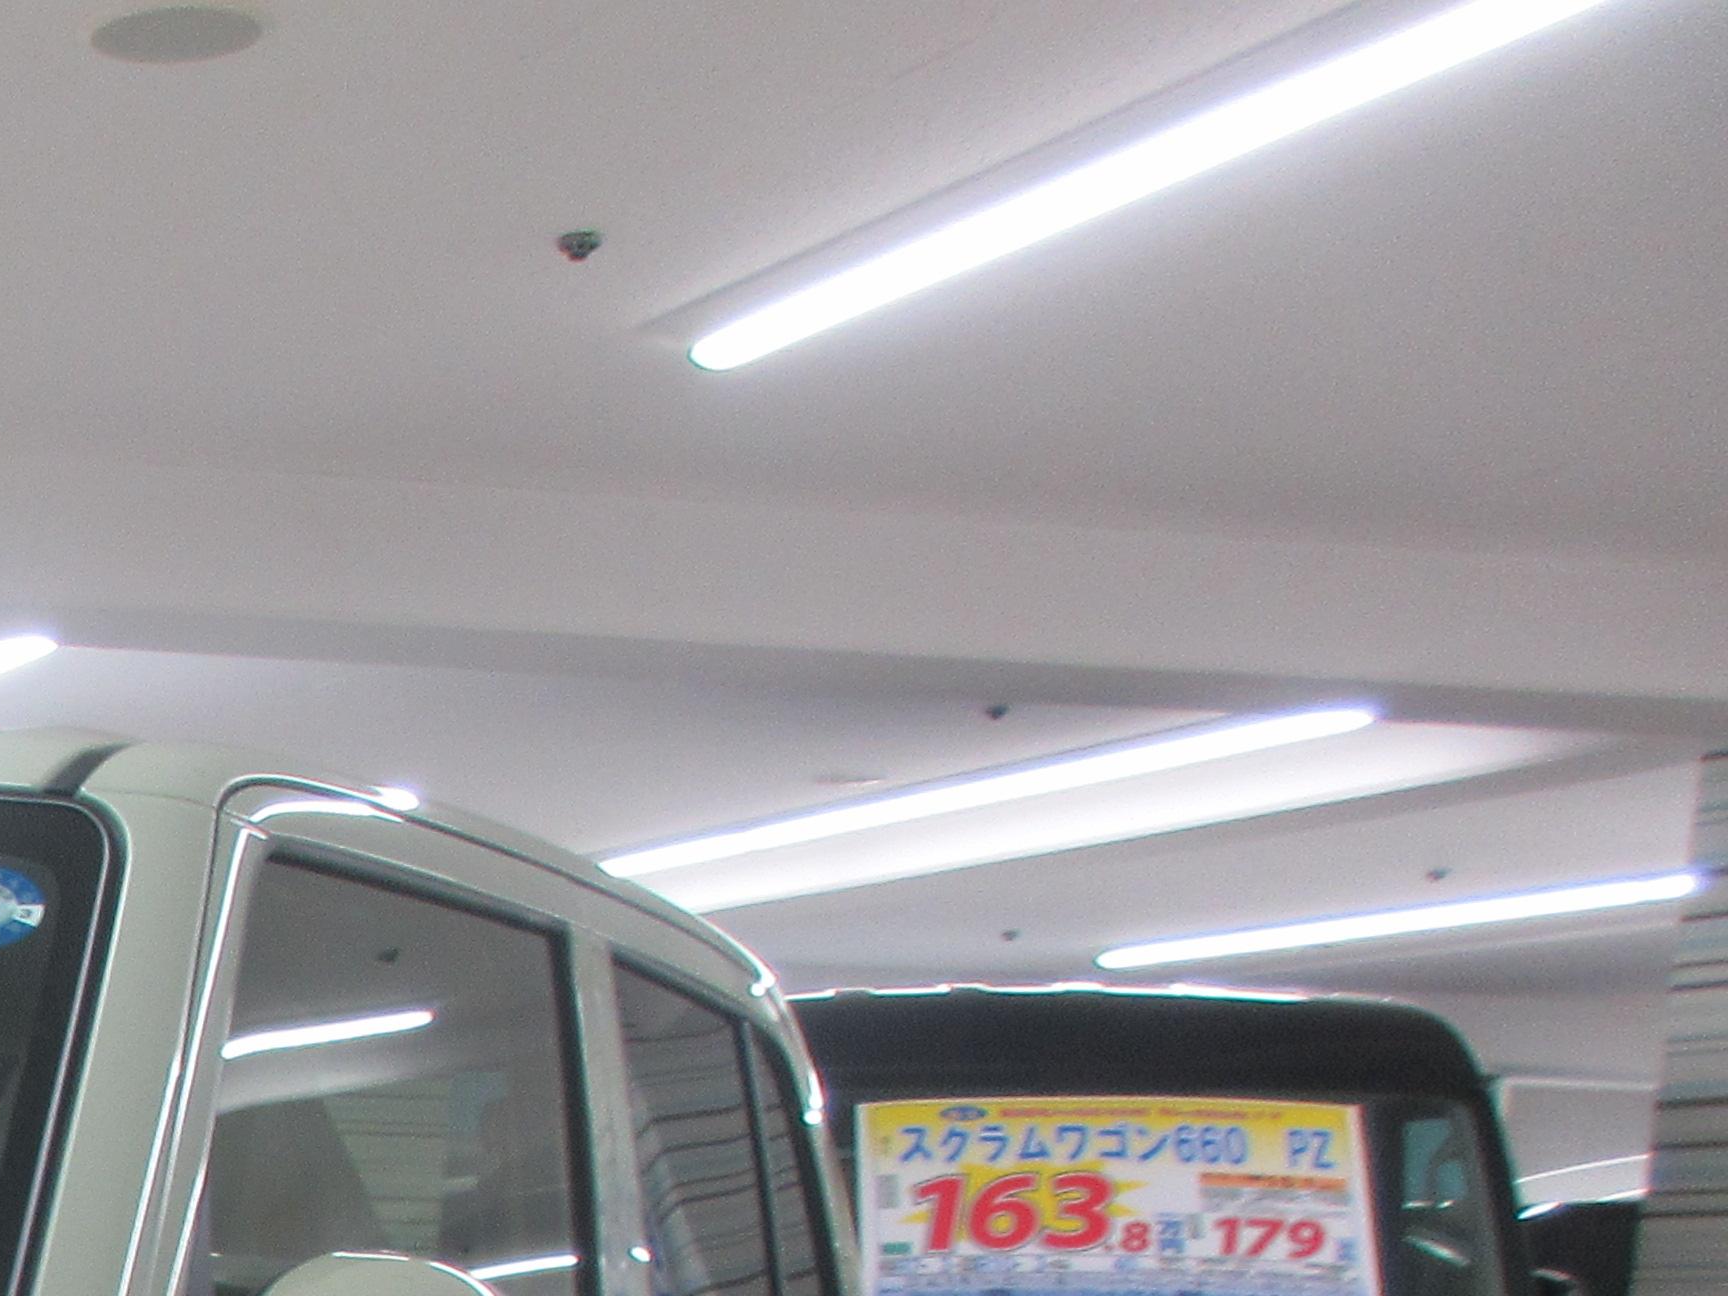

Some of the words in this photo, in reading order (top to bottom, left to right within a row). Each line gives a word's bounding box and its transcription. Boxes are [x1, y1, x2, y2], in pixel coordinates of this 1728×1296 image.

[897, 1122, 1249, 1166] スクラムワゴン660
[1286, 1128, 1337, 1170] PZ
[1213, 1215, 1326, 1259] 179
